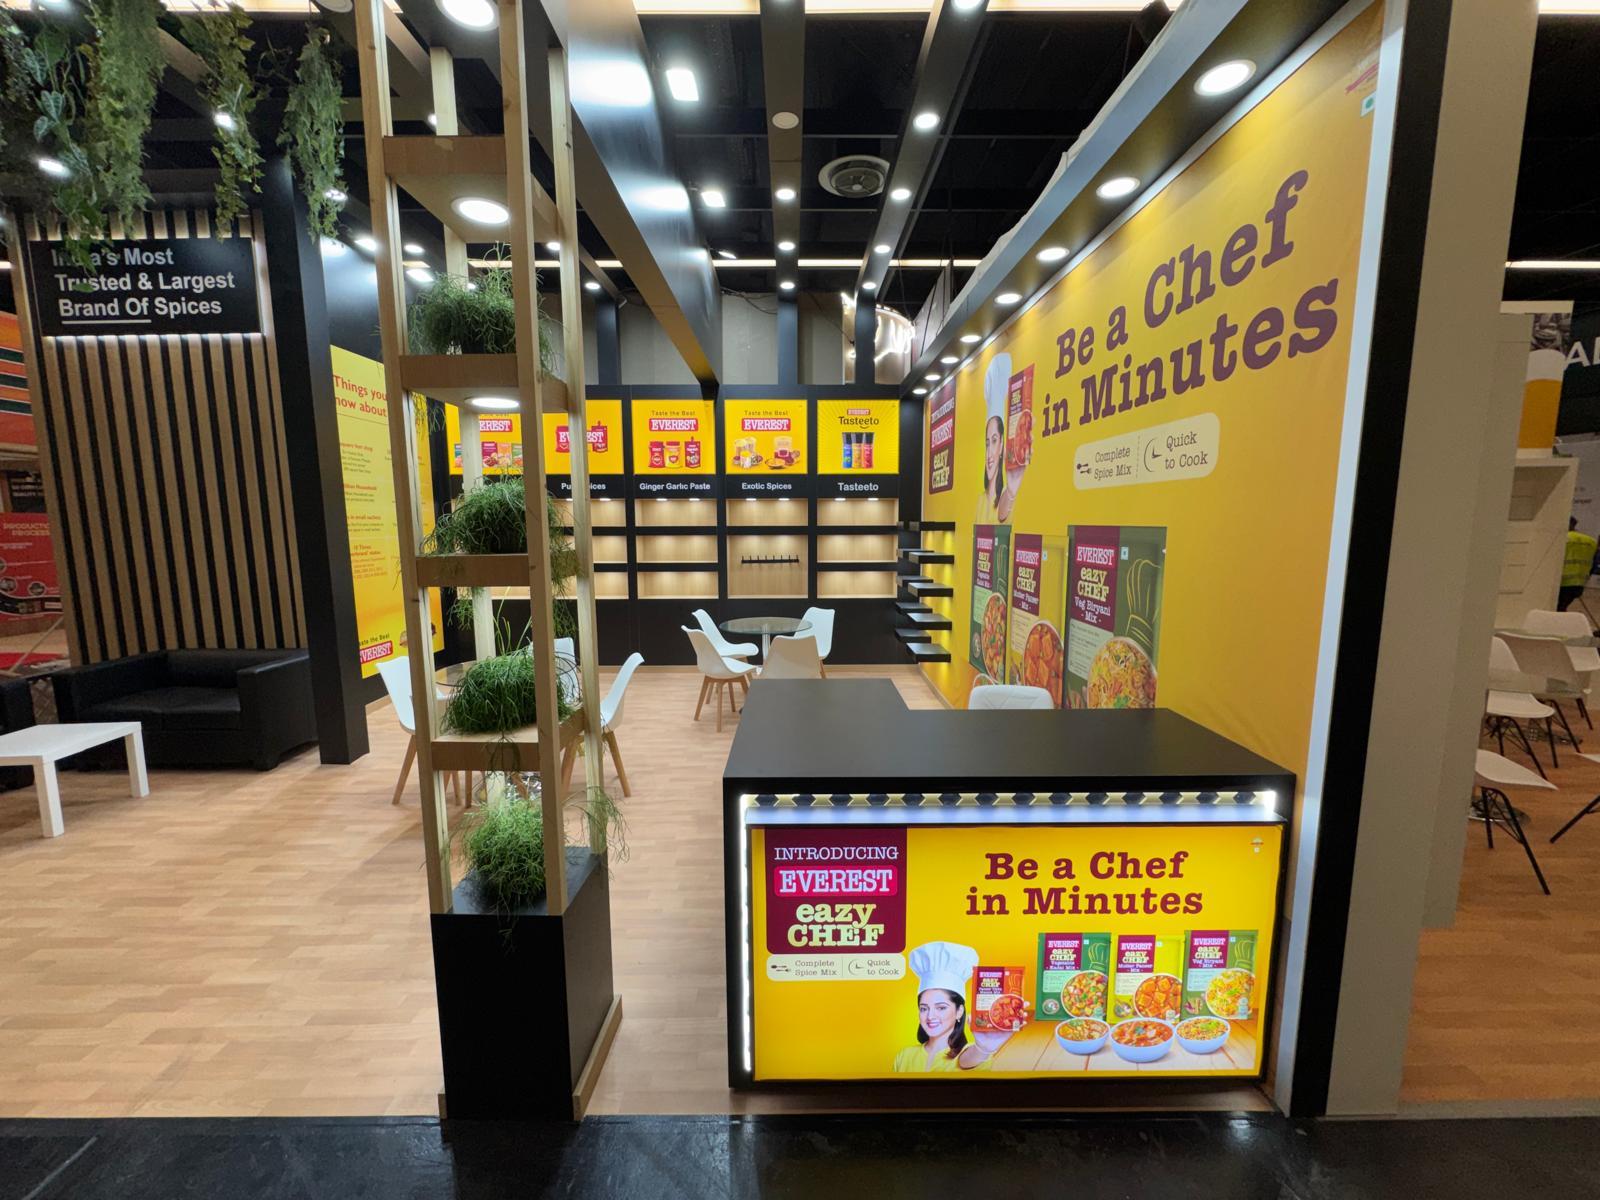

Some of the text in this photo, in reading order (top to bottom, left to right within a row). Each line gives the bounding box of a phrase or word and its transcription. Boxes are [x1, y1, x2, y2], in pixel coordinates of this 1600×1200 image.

[51, 247, 174, 266] Ina's Most
[138, 272, 153, 290] &
[159, 272, 235, 293] Largest
[1055, 169, 1309, 379] Be a Chef
[58, 297, 222, 319] Brand Of Spices
[1042, 278, 1339, 438] in Minutes
[333, 375, 388, 402] Things you
[335, 396, 387, 418] now about
[480, 420, 511, 431] EREST
[651, 419, 697, 430] EVEREST
[744, 419, 789, 430] EVEREST
[838, 416, 880, 426] Tasteeto
[559, 431, 604, 442] EVEST
[1166, 431, 1198, 452] Quick
[1095, 447, 1131, 463] Complete
[1165, 451, 1209, 470] to Cook
[1094, 464, 1132, 481] Spice Mix
[561, 482, 606, 490] Pu ices
[639, 482, 711, 492] Ginger Garlic Paste
[742, 482, 792, 492] Exotic Spices
[838, 482, 879, 491] Tasteeto
[1077, 546, 1114, 565] EVEREST
[1080, 567, 1107, 586] eazy
[1077, 580, 1109, 602] CHEF
[1075, 597, 1111, 616] Veg Biryani
[1085, 611, 1097, 623] Mix
[360, 642, 392, 663] VEREST
[774, 846, 899, 861] INTRODUCING
[984, 851, 1189, 880] Be a Chef
[779, 869, 893, 893] EVEREST
[966, 885, 1203, 915] in Minutes
[796, 903, 877, 929] eazy
[787, 924, 885, 947] CHEF
[795, 960, 834, 968] Complete
[867, 959, 891, 967] Quick
[795, 969, 817, 977] Spice
